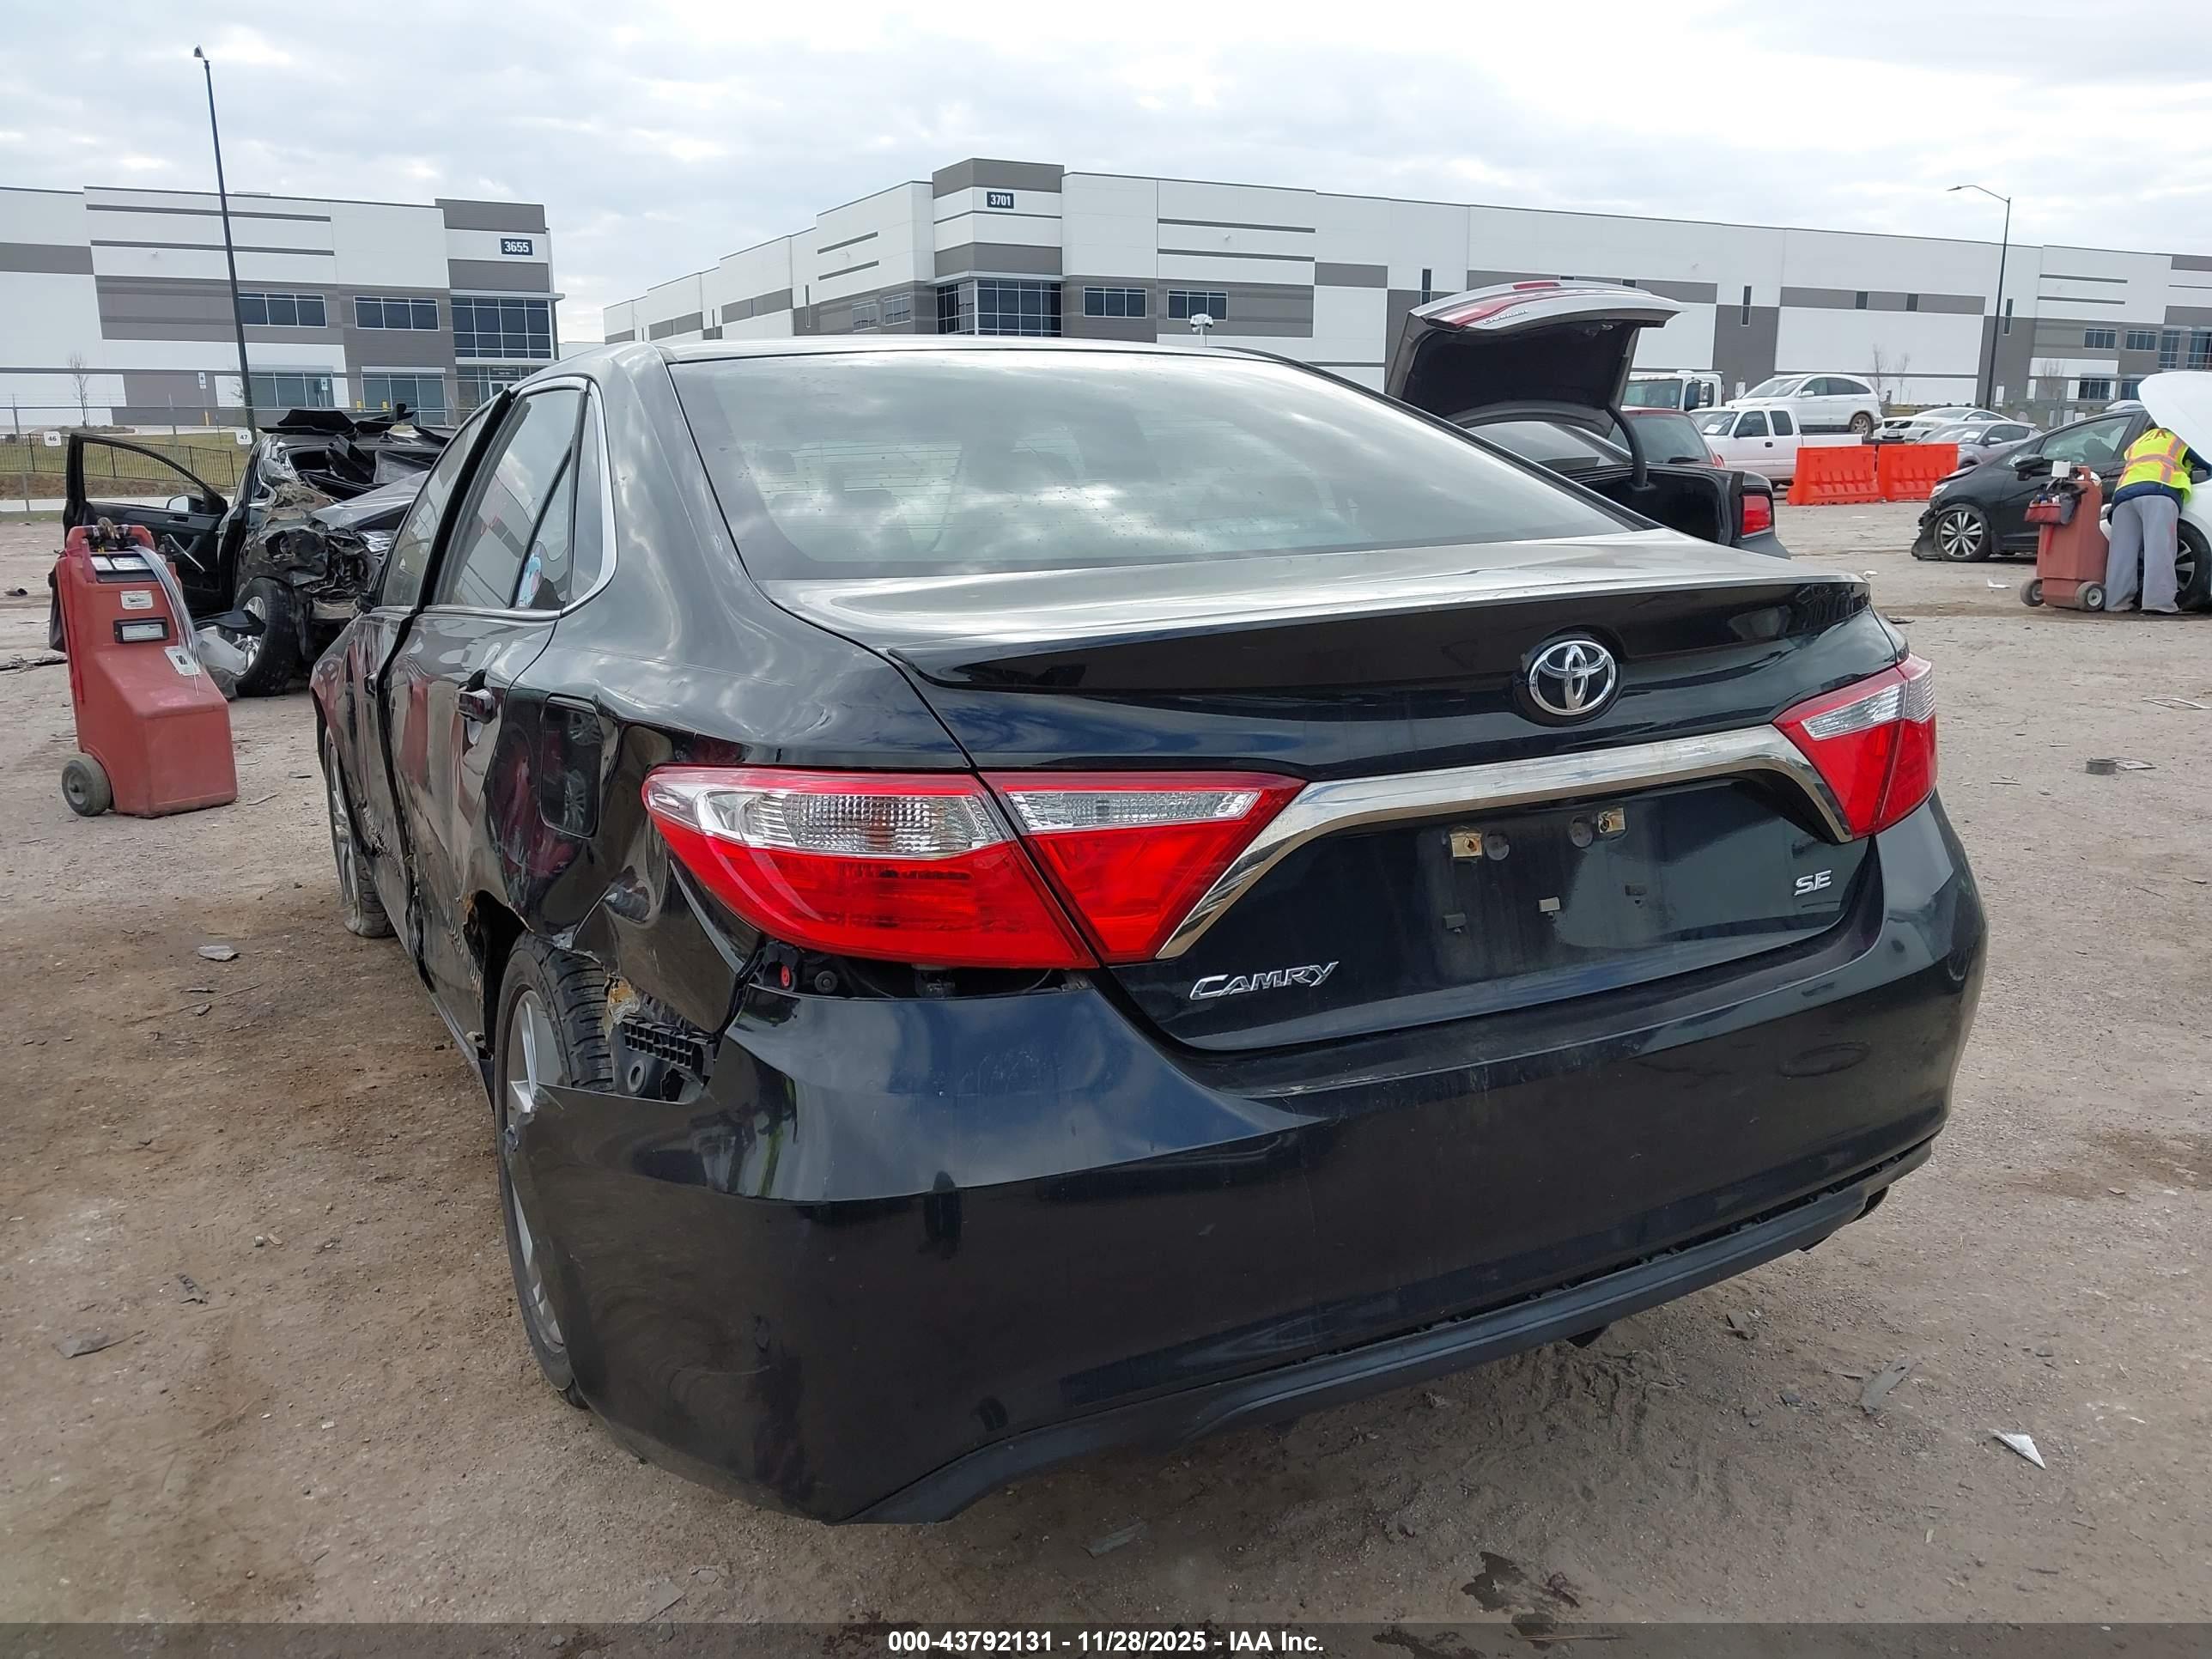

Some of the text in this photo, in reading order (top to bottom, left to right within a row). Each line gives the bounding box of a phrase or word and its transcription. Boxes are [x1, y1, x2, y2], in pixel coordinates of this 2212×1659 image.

[990, 193, 1011, 206] 3701
[504, 240, 529, 252] 3655
[1794, 869, 1832, 896] SE
[1189, 961, 1340, 1000] CAMRY
